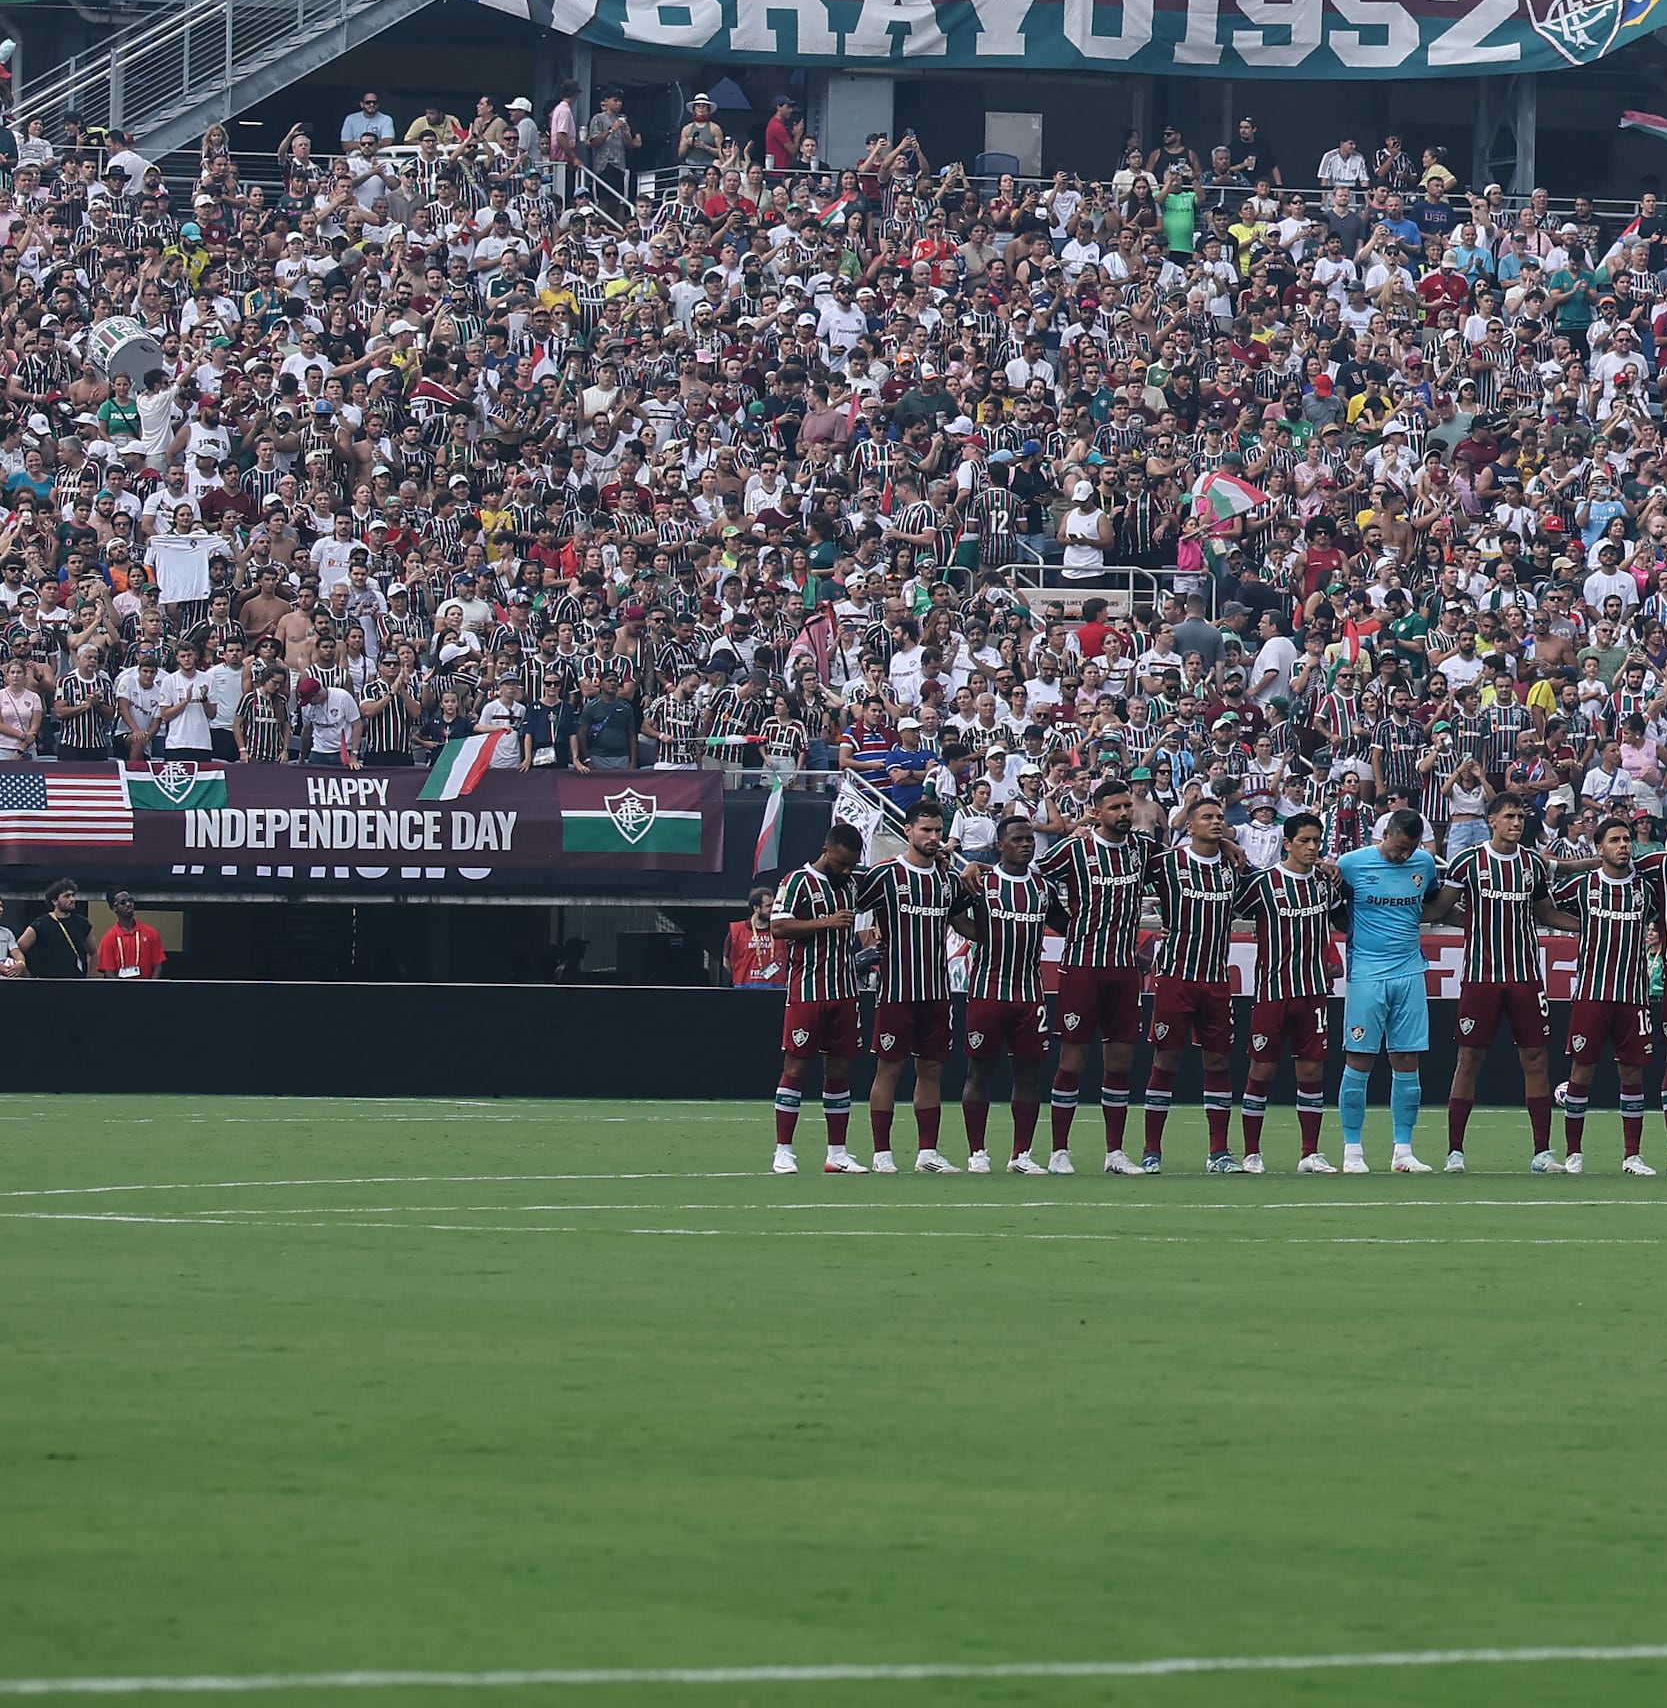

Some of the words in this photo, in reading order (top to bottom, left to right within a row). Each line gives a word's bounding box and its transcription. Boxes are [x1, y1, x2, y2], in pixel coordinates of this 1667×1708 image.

[1424, 212, 1448, 223] USA
[989, 509, 1009, 535] 12
[306, 777, 390, 807] HAPPY
[184, 808, 443, 852] INDEPENDENCE
[451, 810, 518, 852] DAY
[1091, 871, 1141, 887] SUPERBET
[1182, 887, 1233, 903] SUPERBET
[1367, 894, 1424, 907] SUPERBET
[1480, 888, 1532, 902] SUPERBET
[899, 902, 950, 917] SUPERBET
[991, 908, 1046, 923] SUPERBET
[1279, 901, 1330, 918] SUPERBET
[1589, 905, 1642, 921] SUPERBET
[1538, 990, 1549, 1018] 5
[1637, 1008, 1652, 1036] 16
